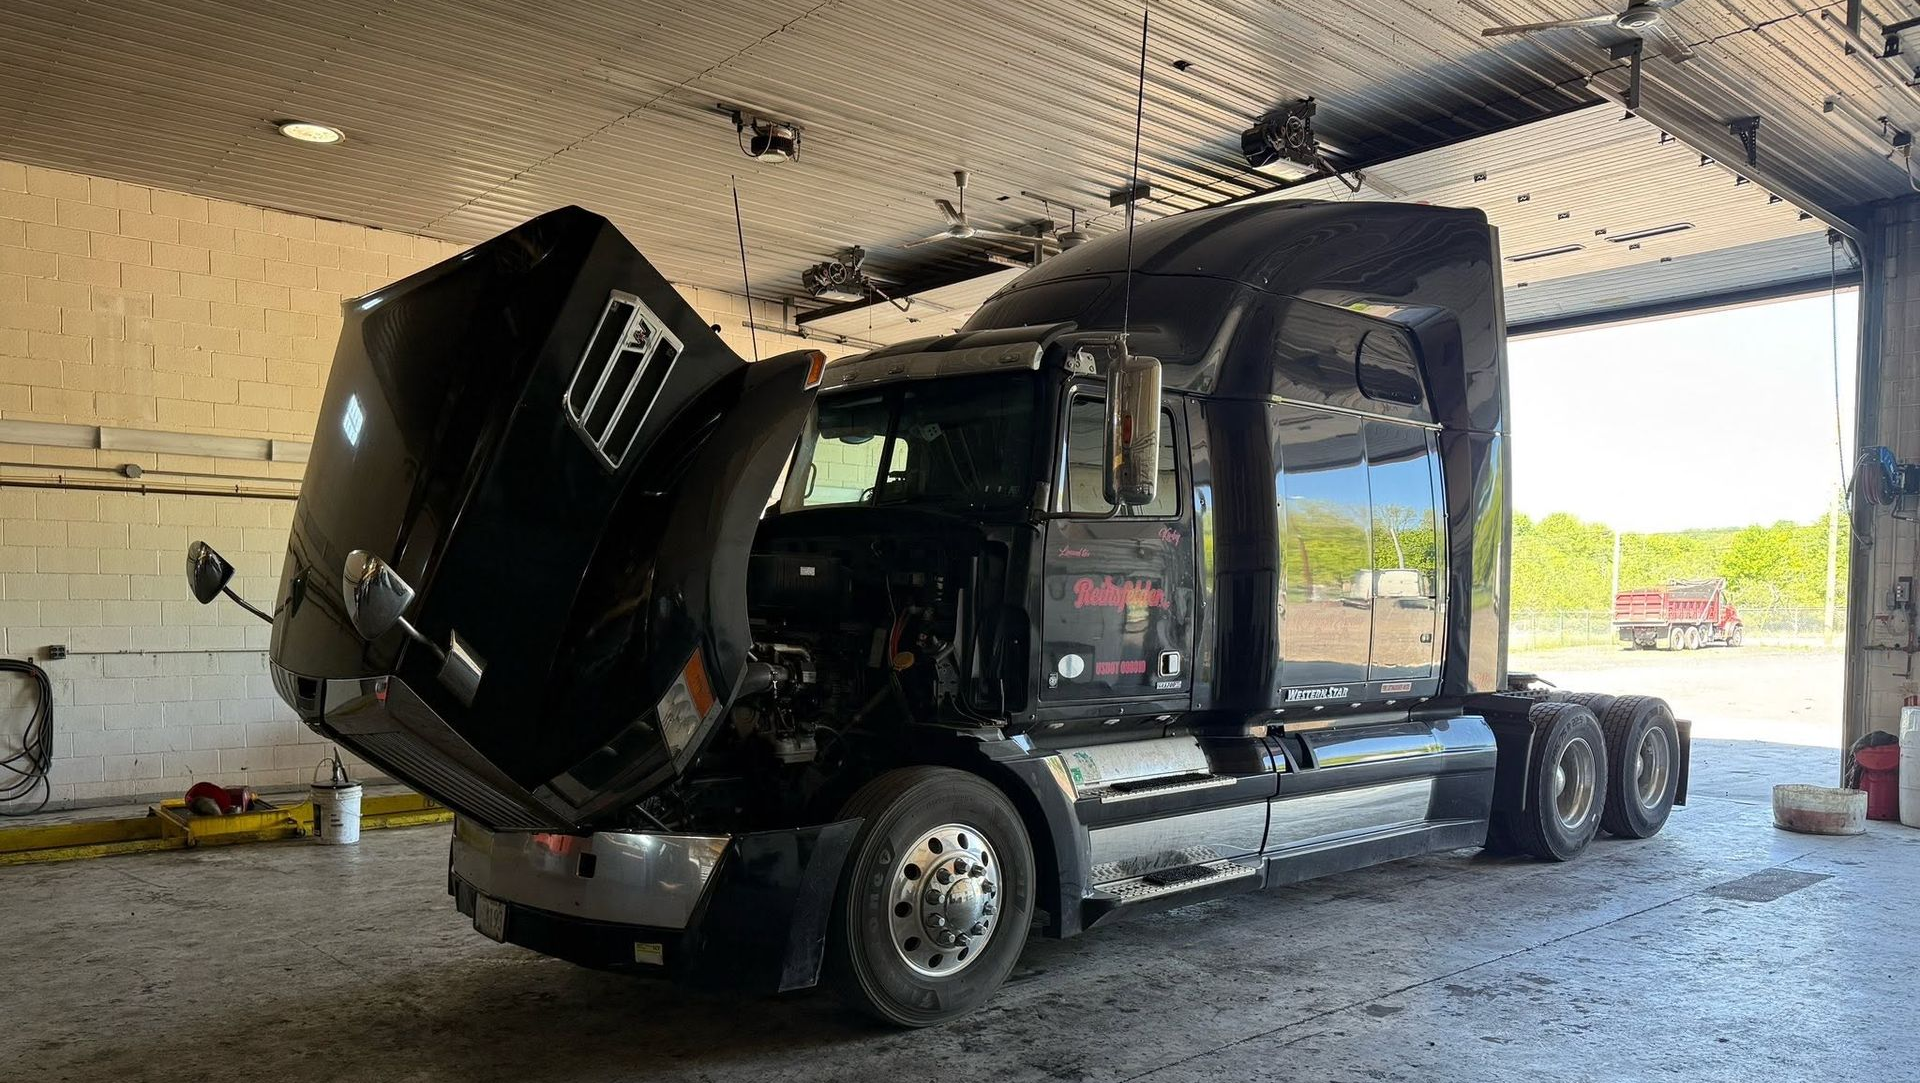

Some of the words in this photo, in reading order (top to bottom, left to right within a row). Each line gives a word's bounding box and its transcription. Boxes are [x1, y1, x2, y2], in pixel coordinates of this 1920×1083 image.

[1096, 661, 1119, 675] USDOT
[1286, 689, 1326, 702] WESTERN
[1327, 687, 1349, 699] STAR
